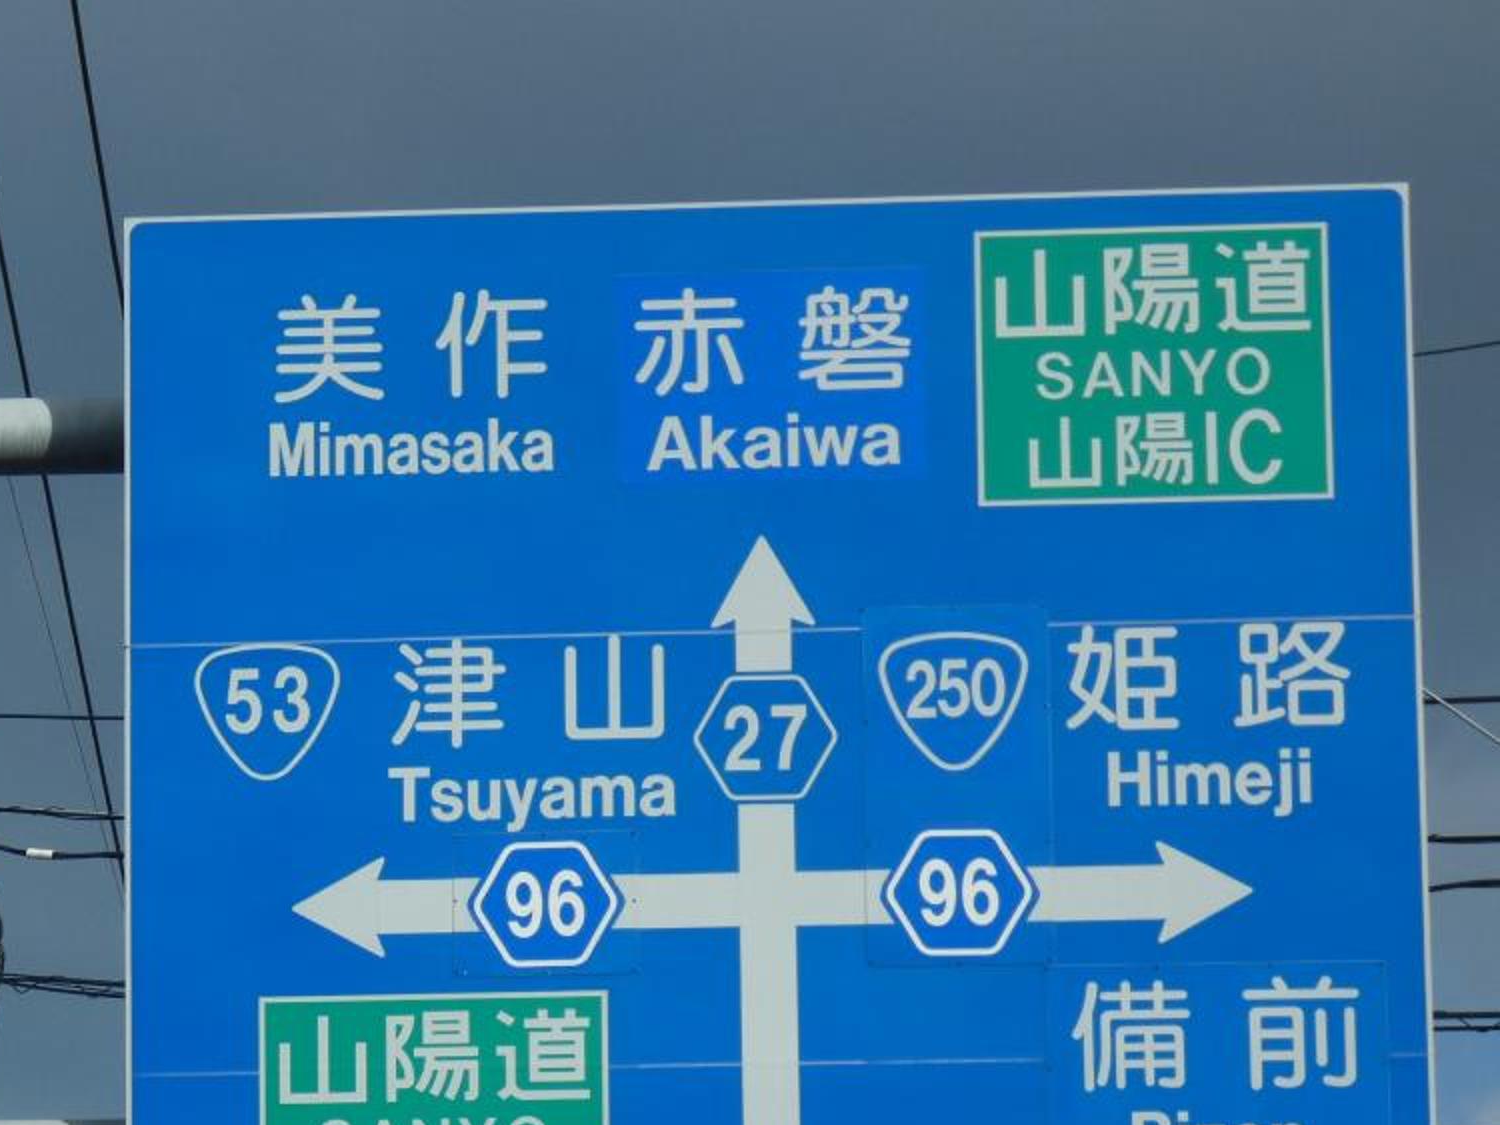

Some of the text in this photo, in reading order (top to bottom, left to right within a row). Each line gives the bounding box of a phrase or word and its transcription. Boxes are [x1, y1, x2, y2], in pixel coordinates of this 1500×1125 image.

[993, 240, 1312, 338] 山陽道
[276, 291, 546, 402] 美作
[636, 287, 909, 394] 赤磐
[1039, 348, 1268, 398] SANYO
[270, 419, 552, 476] Mimasaka
[649, 415, 899, 470] Akaiwa
[1030, 410, 1280, 487] 山陽IC
[224, 668, 311, 735] 53
[393, 634, 664, 747] 津山
[904, 659, 1007, 720] 250
[1068, 622, 1349, 729] 姫路
[726, 705, 806, 770] 27
[389, 767, 676, 833] Tsuyama
[1109, 749, 1310, 815] Himeji
[506, 870, 584, 938] 96
[920, 858, 999, 926] 96
[280, 1010, 589, 1103] 山陽道
[1074, 978, 1357, 1090] 備前
